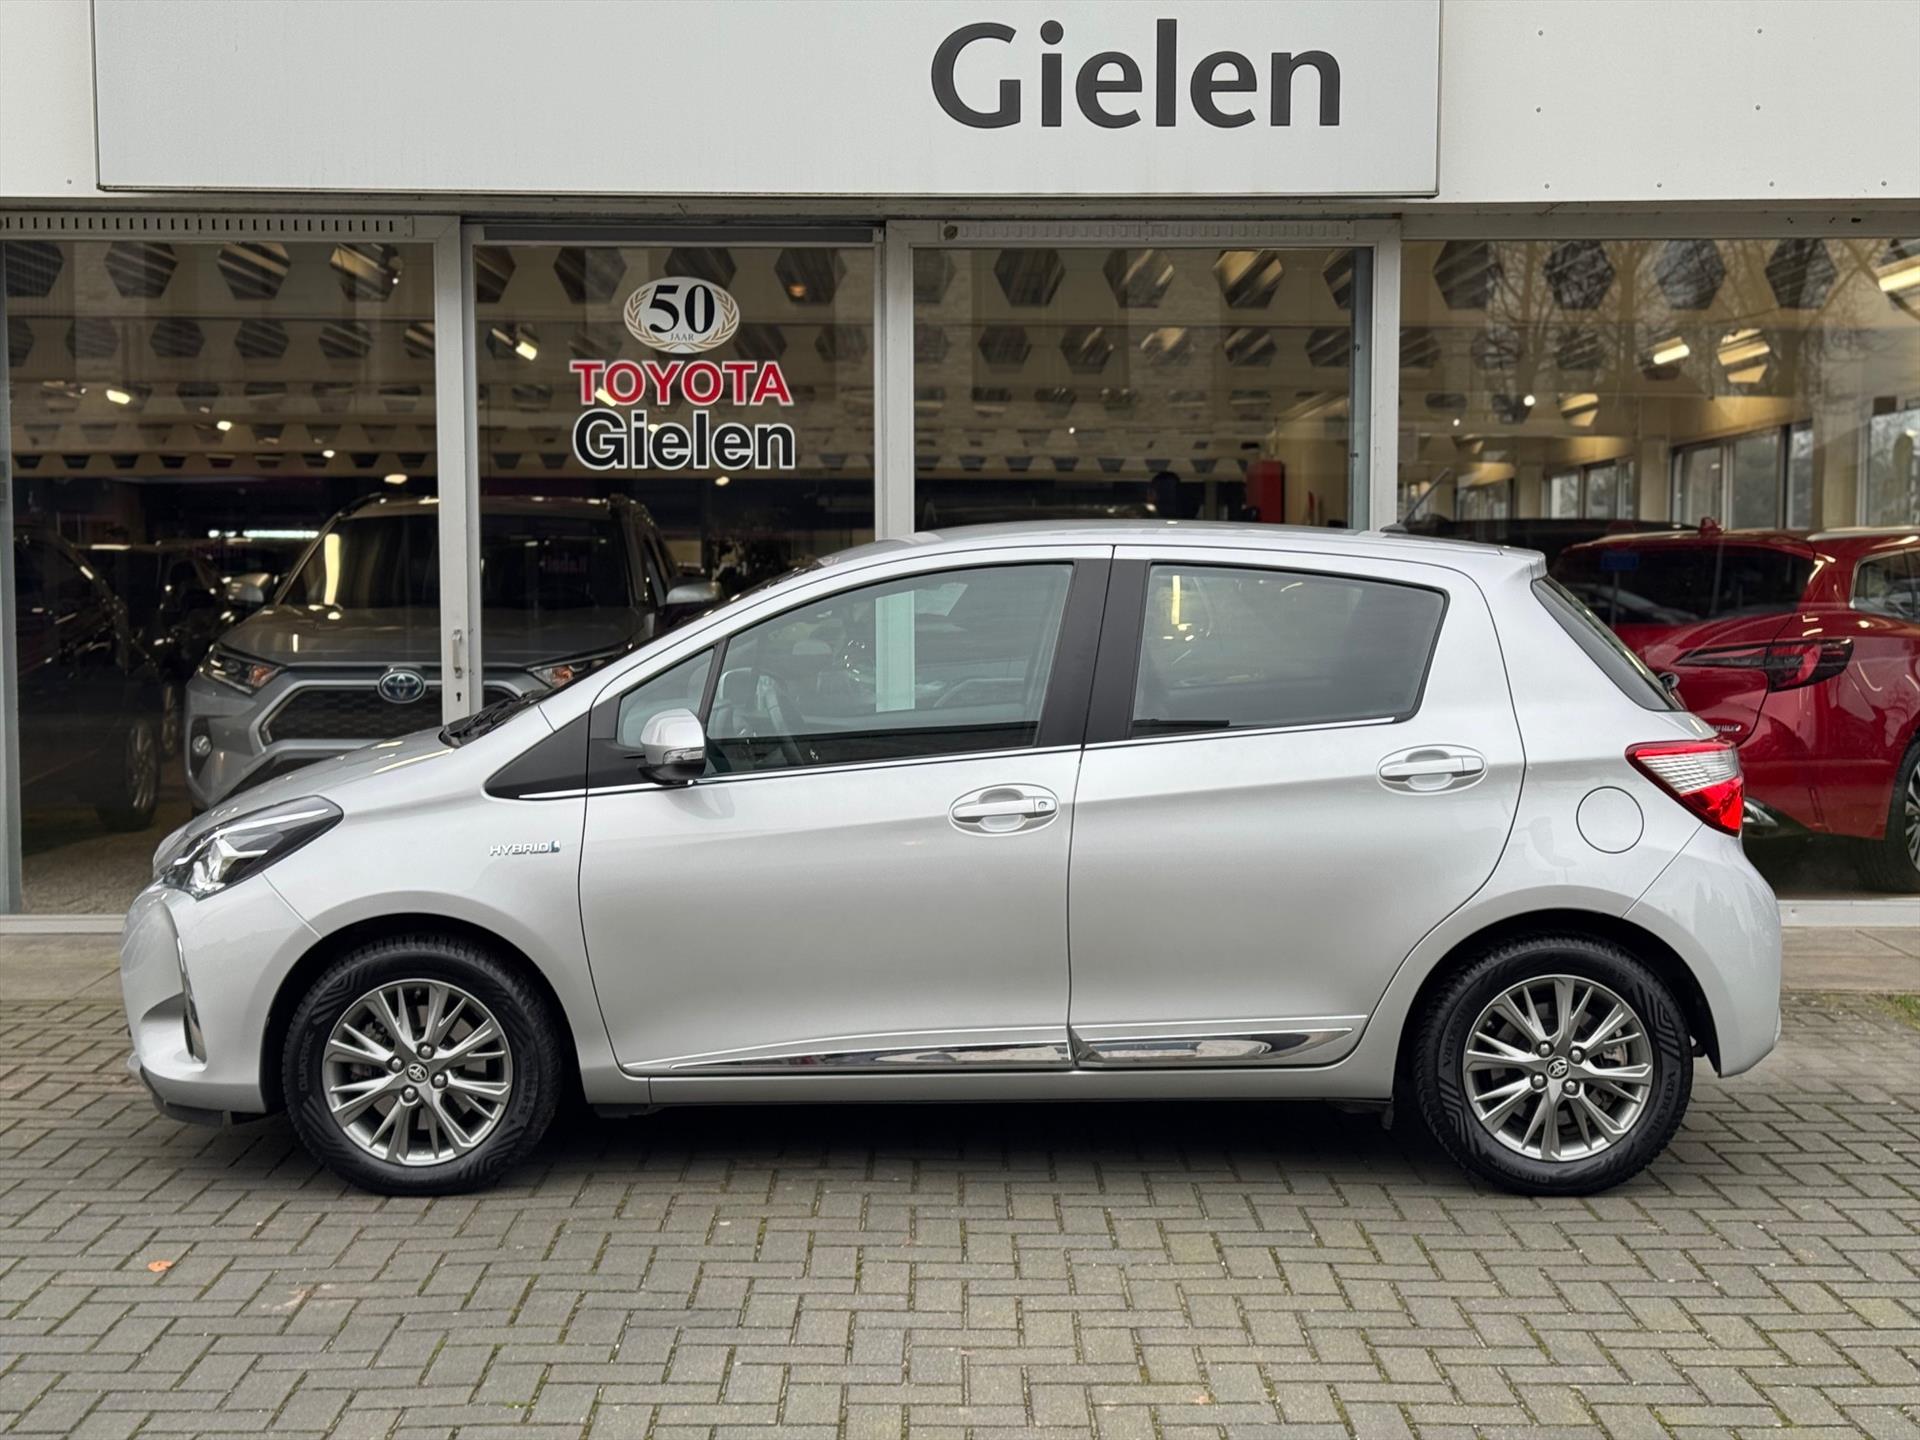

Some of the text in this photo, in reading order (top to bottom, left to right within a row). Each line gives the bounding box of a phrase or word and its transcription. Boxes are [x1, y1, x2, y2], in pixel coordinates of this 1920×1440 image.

[931, 18, 1340, 129] Gielen
[649, 284, 715, 334] 50
[668, 333, 696, 342] JAAR
[569, 360, 794, 405] TOYOTA
[572, 408, 796, 470] Gielen
[489, 842, 549, 856] HYBRID
